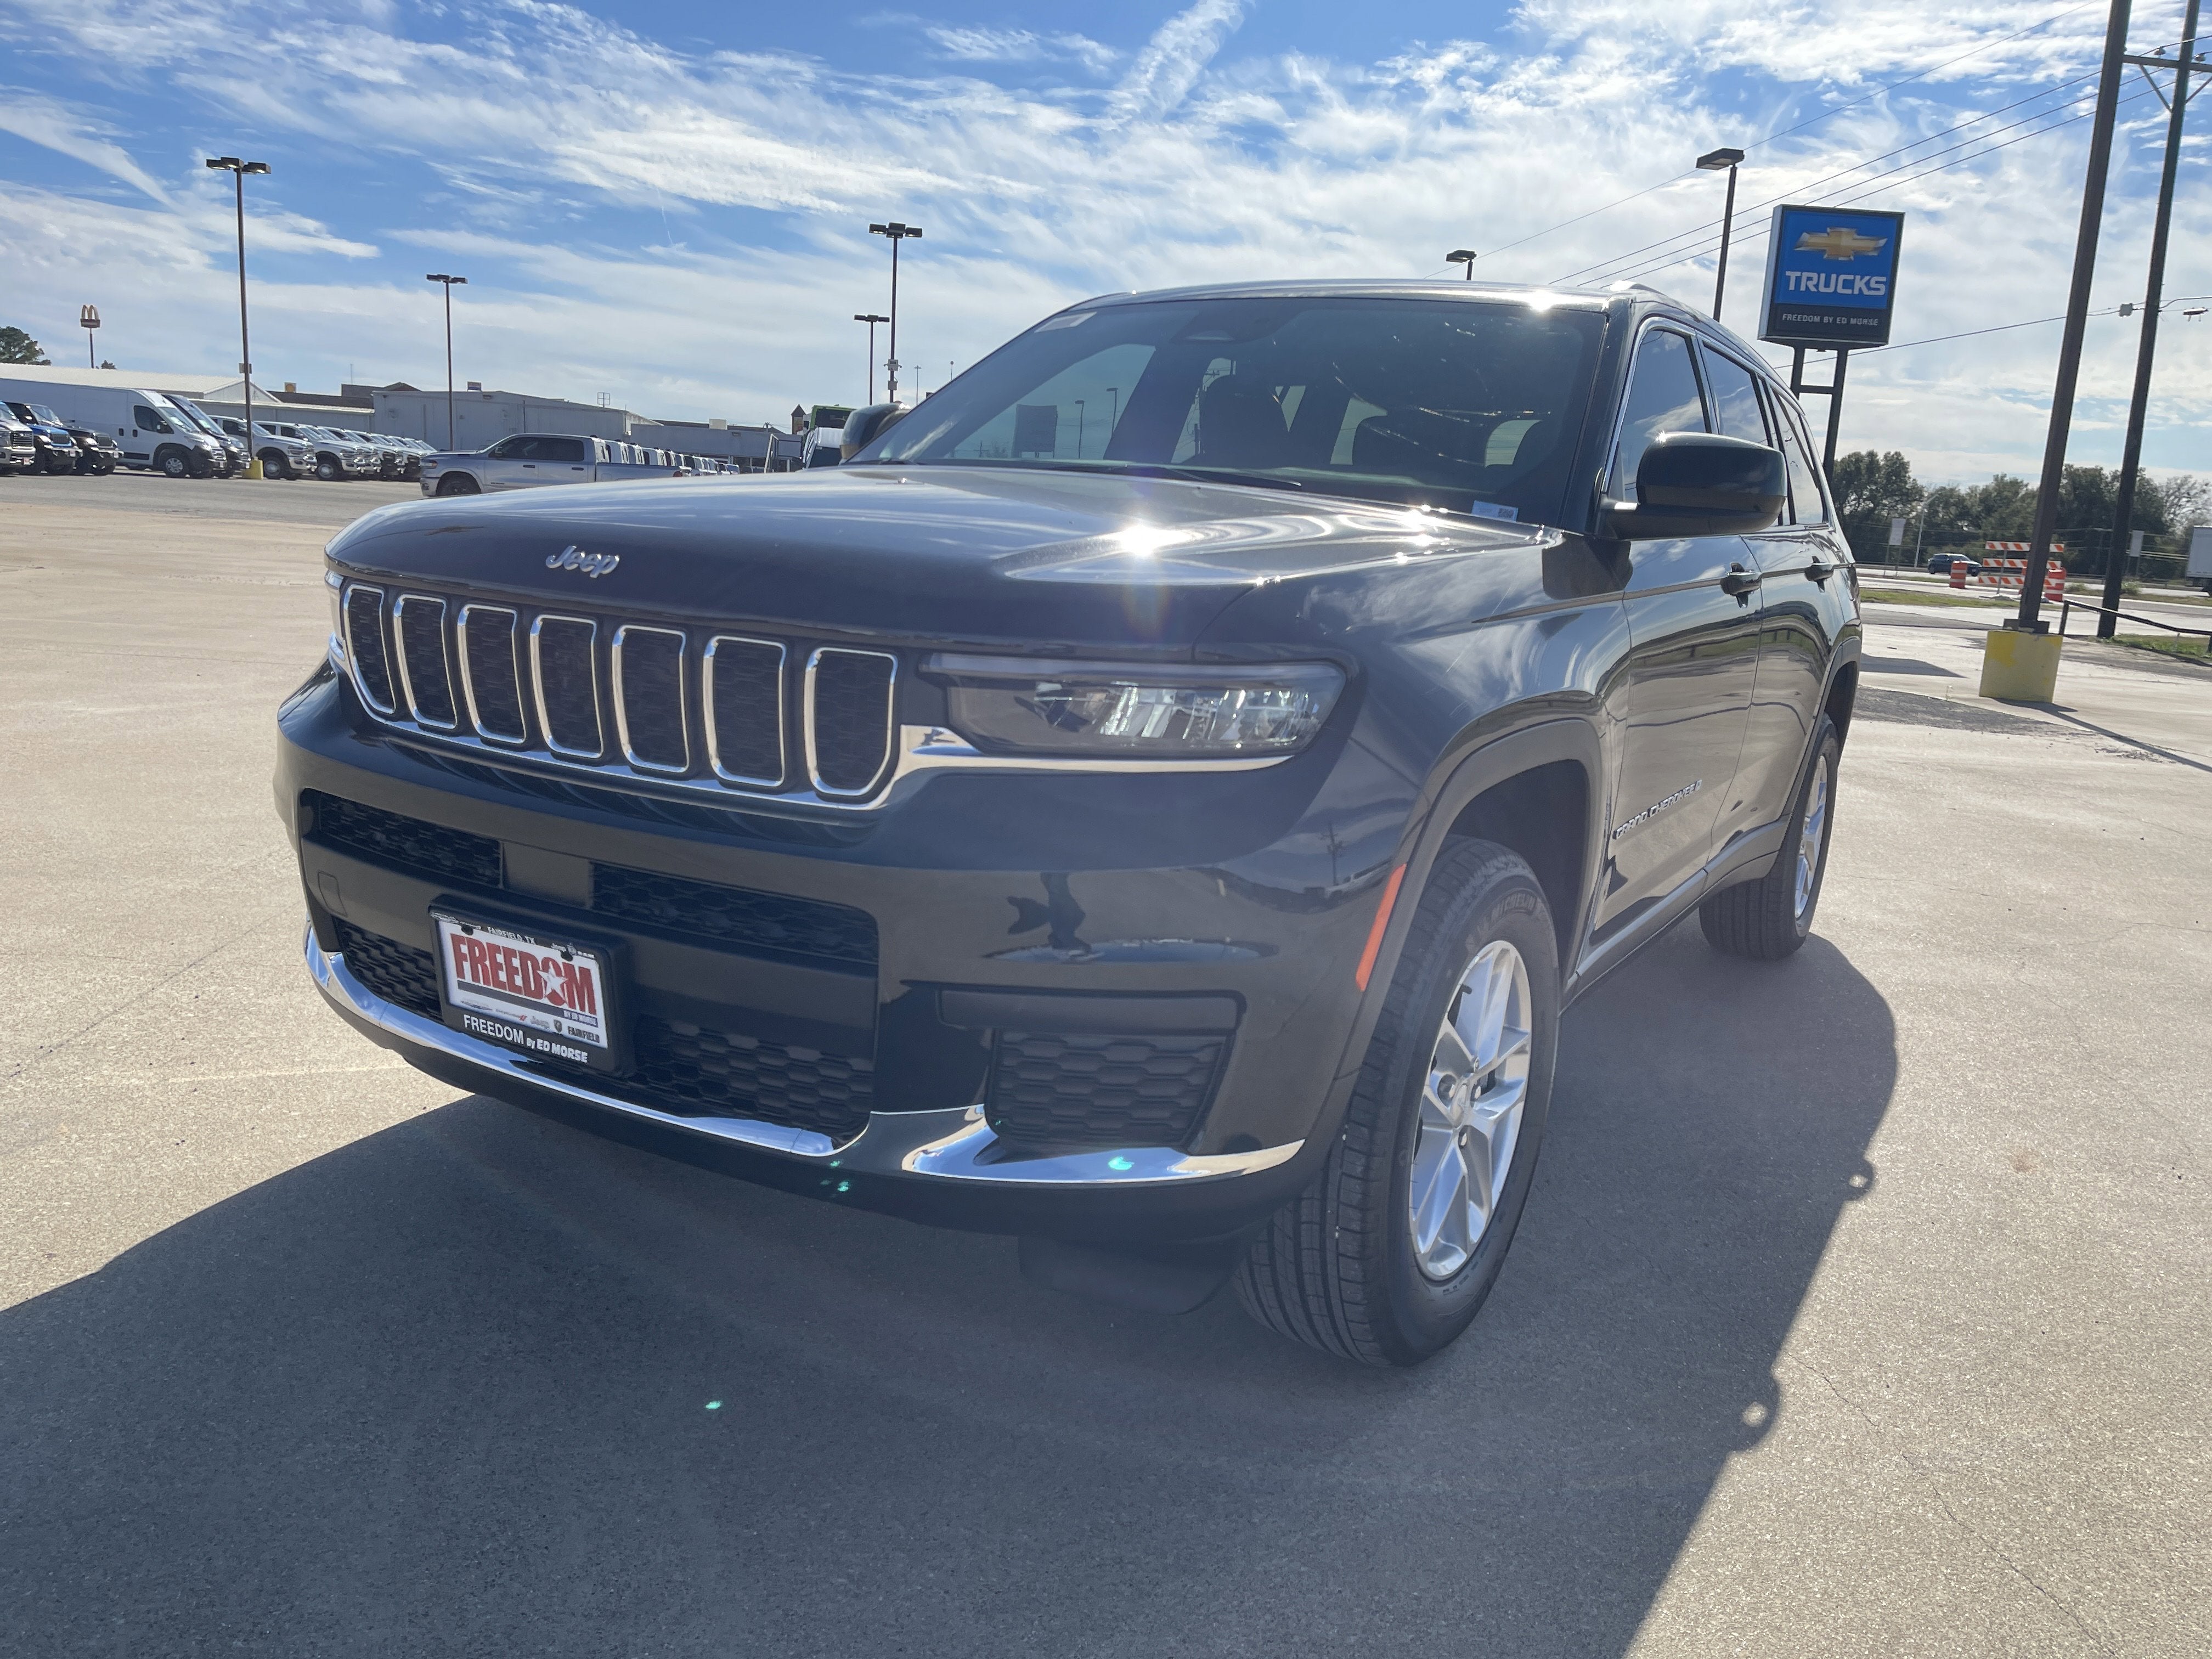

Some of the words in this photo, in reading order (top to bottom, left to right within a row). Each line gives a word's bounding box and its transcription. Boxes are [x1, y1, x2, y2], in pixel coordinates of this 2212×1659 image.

[1786, 270, 1886, 296] TRUCKS
[1782, 313, 1820, 323] FREEDOM
[1850, 318, 1878, 326] MORSE
[545, 545, 620, 578] Jeep
[450, 933, 597, 1015] FREEDOM
[464, 1014, 524, 1045] FREEDOM
[537, 1039, 550, 1052] ED
[551, 1042, 588, 1063] MORSE
